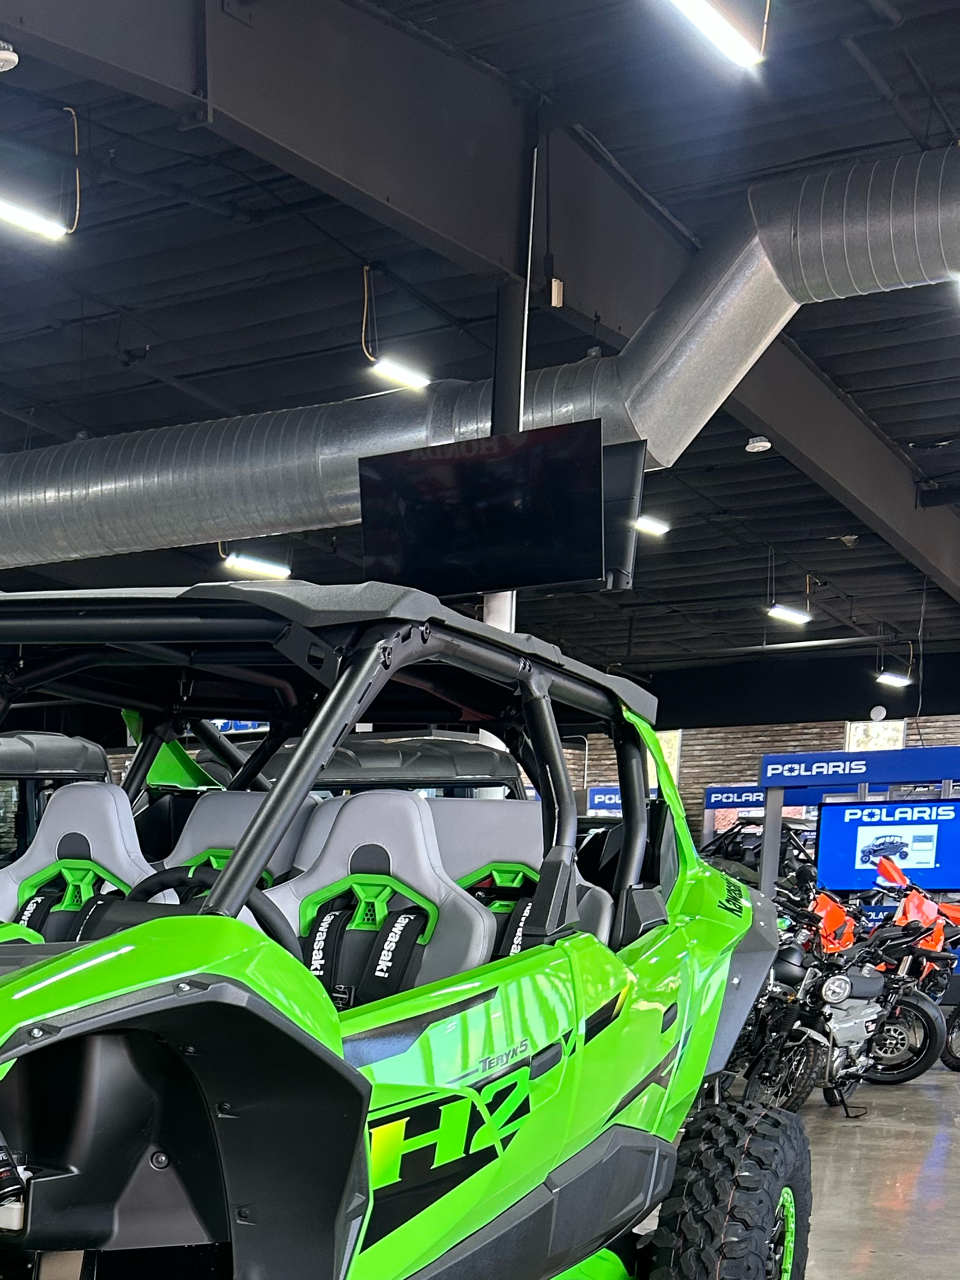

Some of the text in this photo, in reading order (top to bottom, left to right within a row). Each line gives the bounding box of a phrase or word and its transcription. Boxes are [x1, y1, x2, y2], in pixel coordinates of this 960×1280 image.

[766, 760, 867, 777] POLARIS
[711, 792, 764, 803] POLAR
[844, 806, 956, 822] POLARIS
[369, 1065, 532, 1191] H2
